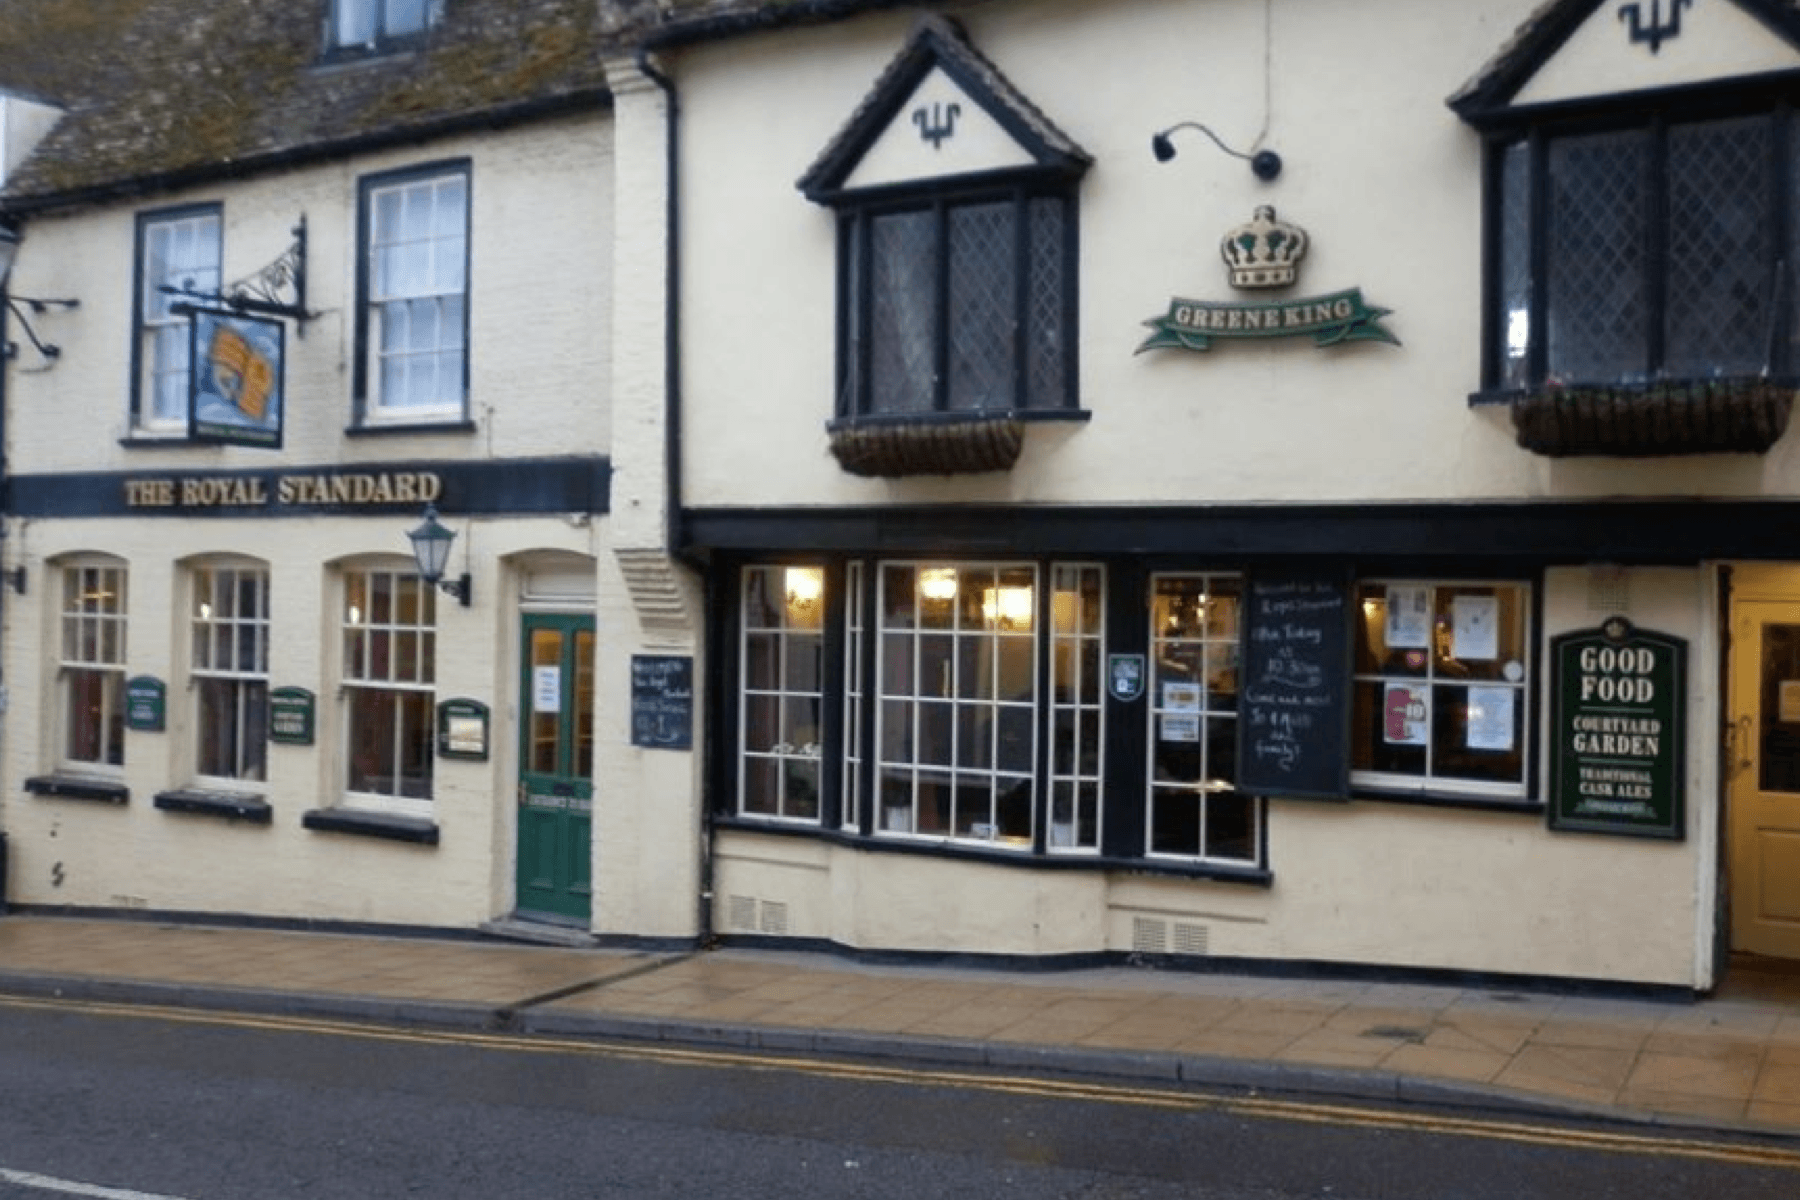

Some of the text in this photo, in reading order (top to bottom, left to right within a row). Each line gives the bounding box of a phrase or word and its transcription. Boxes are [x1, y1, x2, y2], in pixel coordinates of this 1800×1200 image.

[1175, 299, 1351, 329] GREENE KING
[125, 472, 441, 505] THE ROYAL STANDARD
[1580, 647, 1655, 675] GOOD
[1580, 676, 1654, 703] FOOD
[1573, 715, 1661, 735] COURTYARD
[1573, 733, 1660, 756] GARDEN
[1579, 781, 1653, 799] CASK ALES
